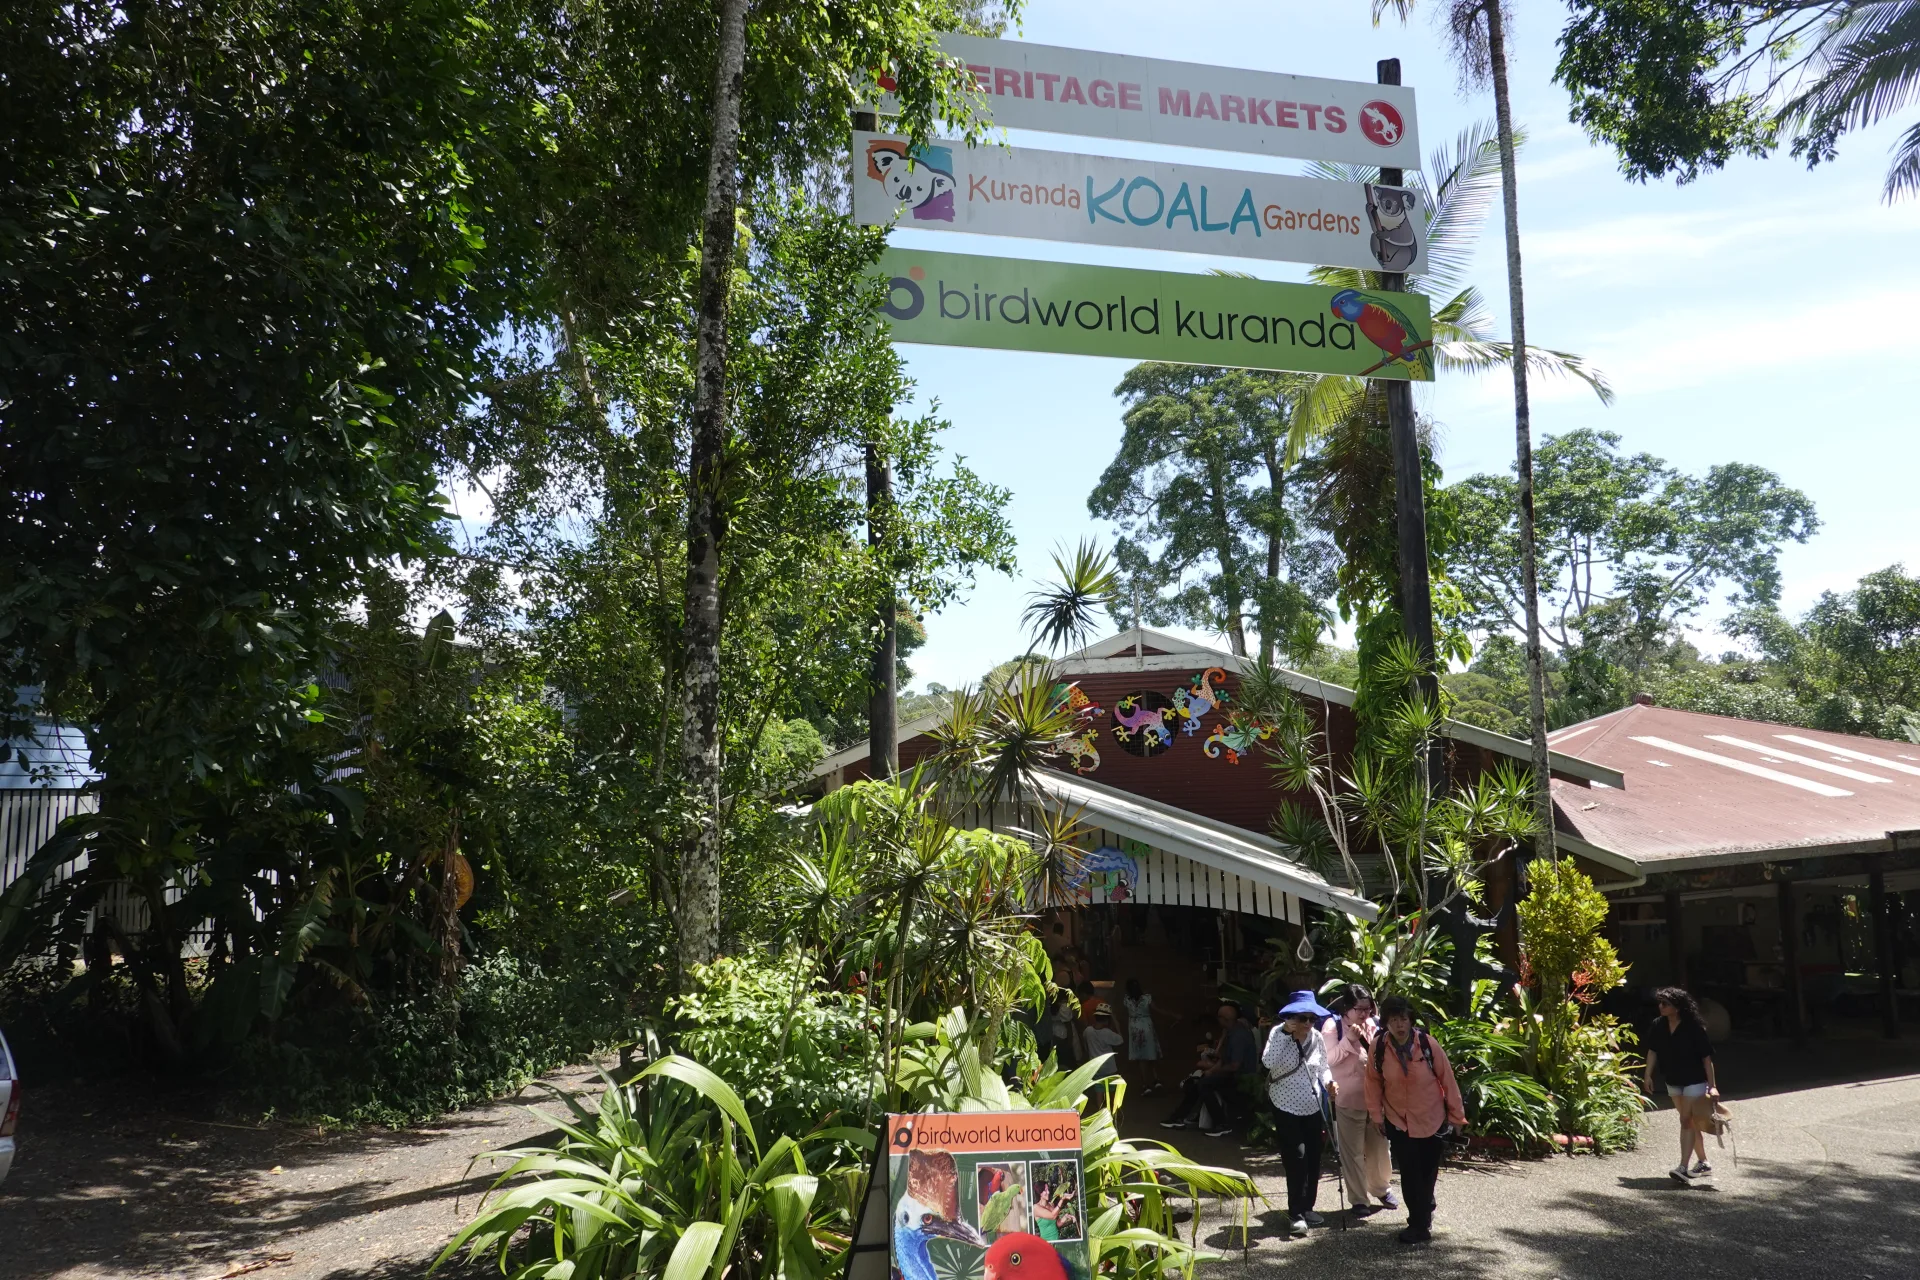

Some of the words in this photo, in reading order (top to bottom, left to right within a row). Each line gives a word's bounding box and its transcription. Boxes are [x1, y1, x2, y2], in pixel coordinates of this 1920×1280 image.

[1158, 86, 1348, 134] MARKETS
[968, 174, 1081, 210] Kuranda
[1086, 176, 1262, 238] KOALA
[1263, 204, 1361, 235] Gardens
[939, 280, 1160, 335] birdworld
[1176, 300, 1356, 351] kuranda
[917, 1126, 1000, 1145] birdworld
[1006, 1125, 1076, 1143] kuranda
